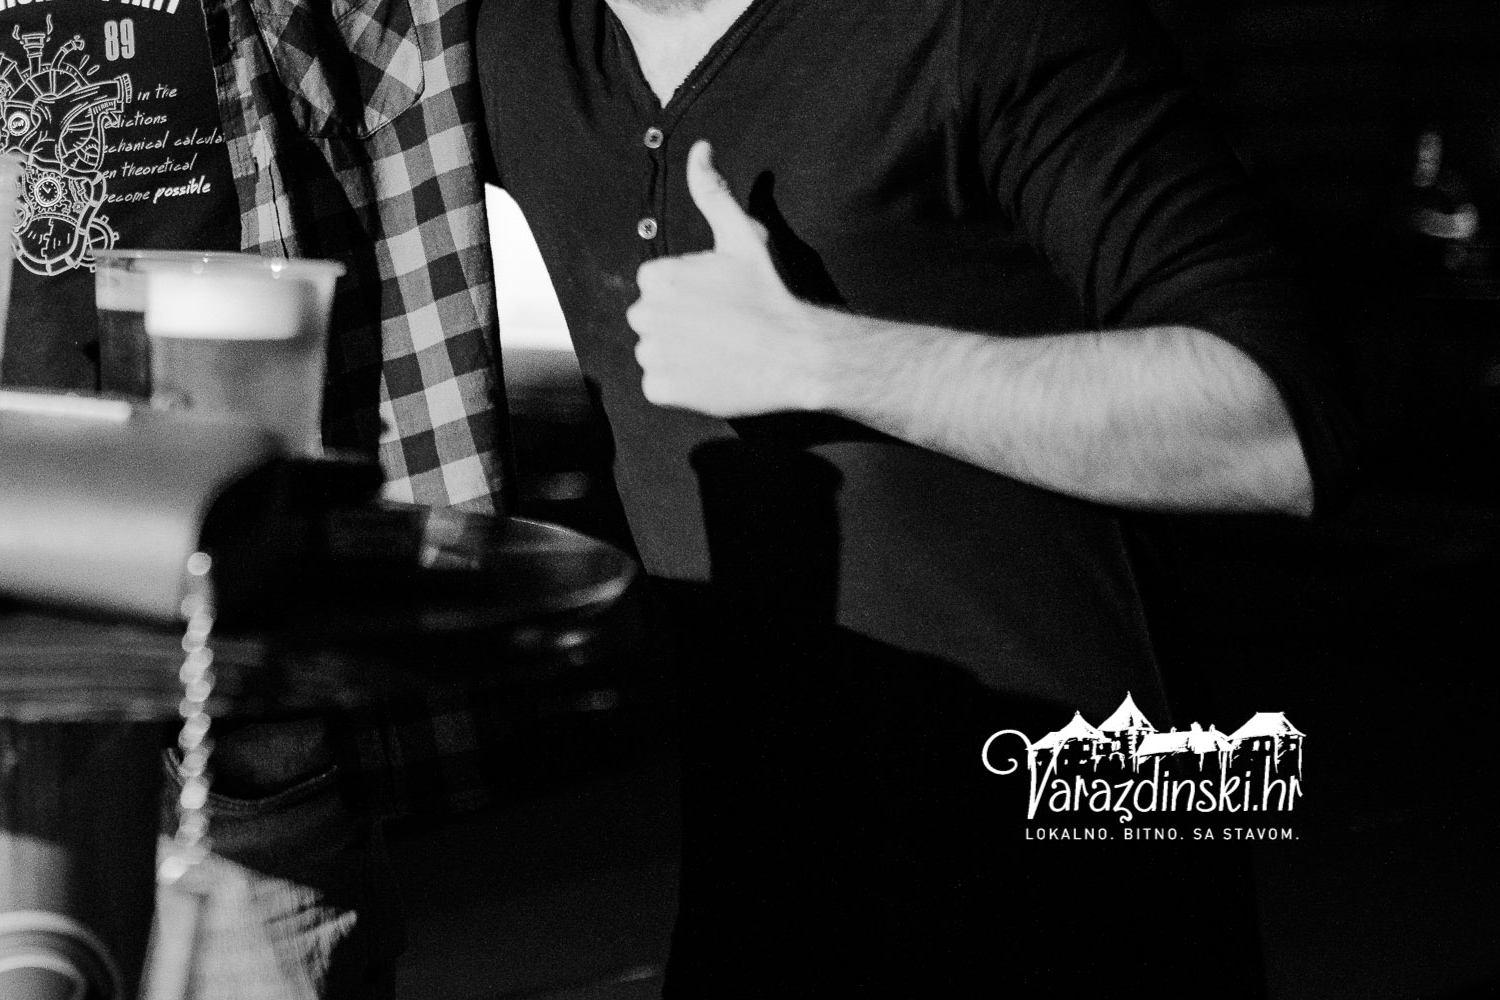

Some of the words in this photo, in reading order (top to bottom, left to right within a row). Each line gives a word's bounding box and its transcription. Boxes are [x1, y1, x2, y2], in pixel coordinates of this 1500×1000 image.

[104, 18, 136, 61] 89
[137, 89, 150, 101] in
[155, 83, 178, 99] the
[103, 111, 168, 129] edictions
[102, 130, 170, 154] echanical
[173, 127, 226, 146] calcula
[121, 152, 198, 178] theoretical
[152, 175, 211, 204] possible
